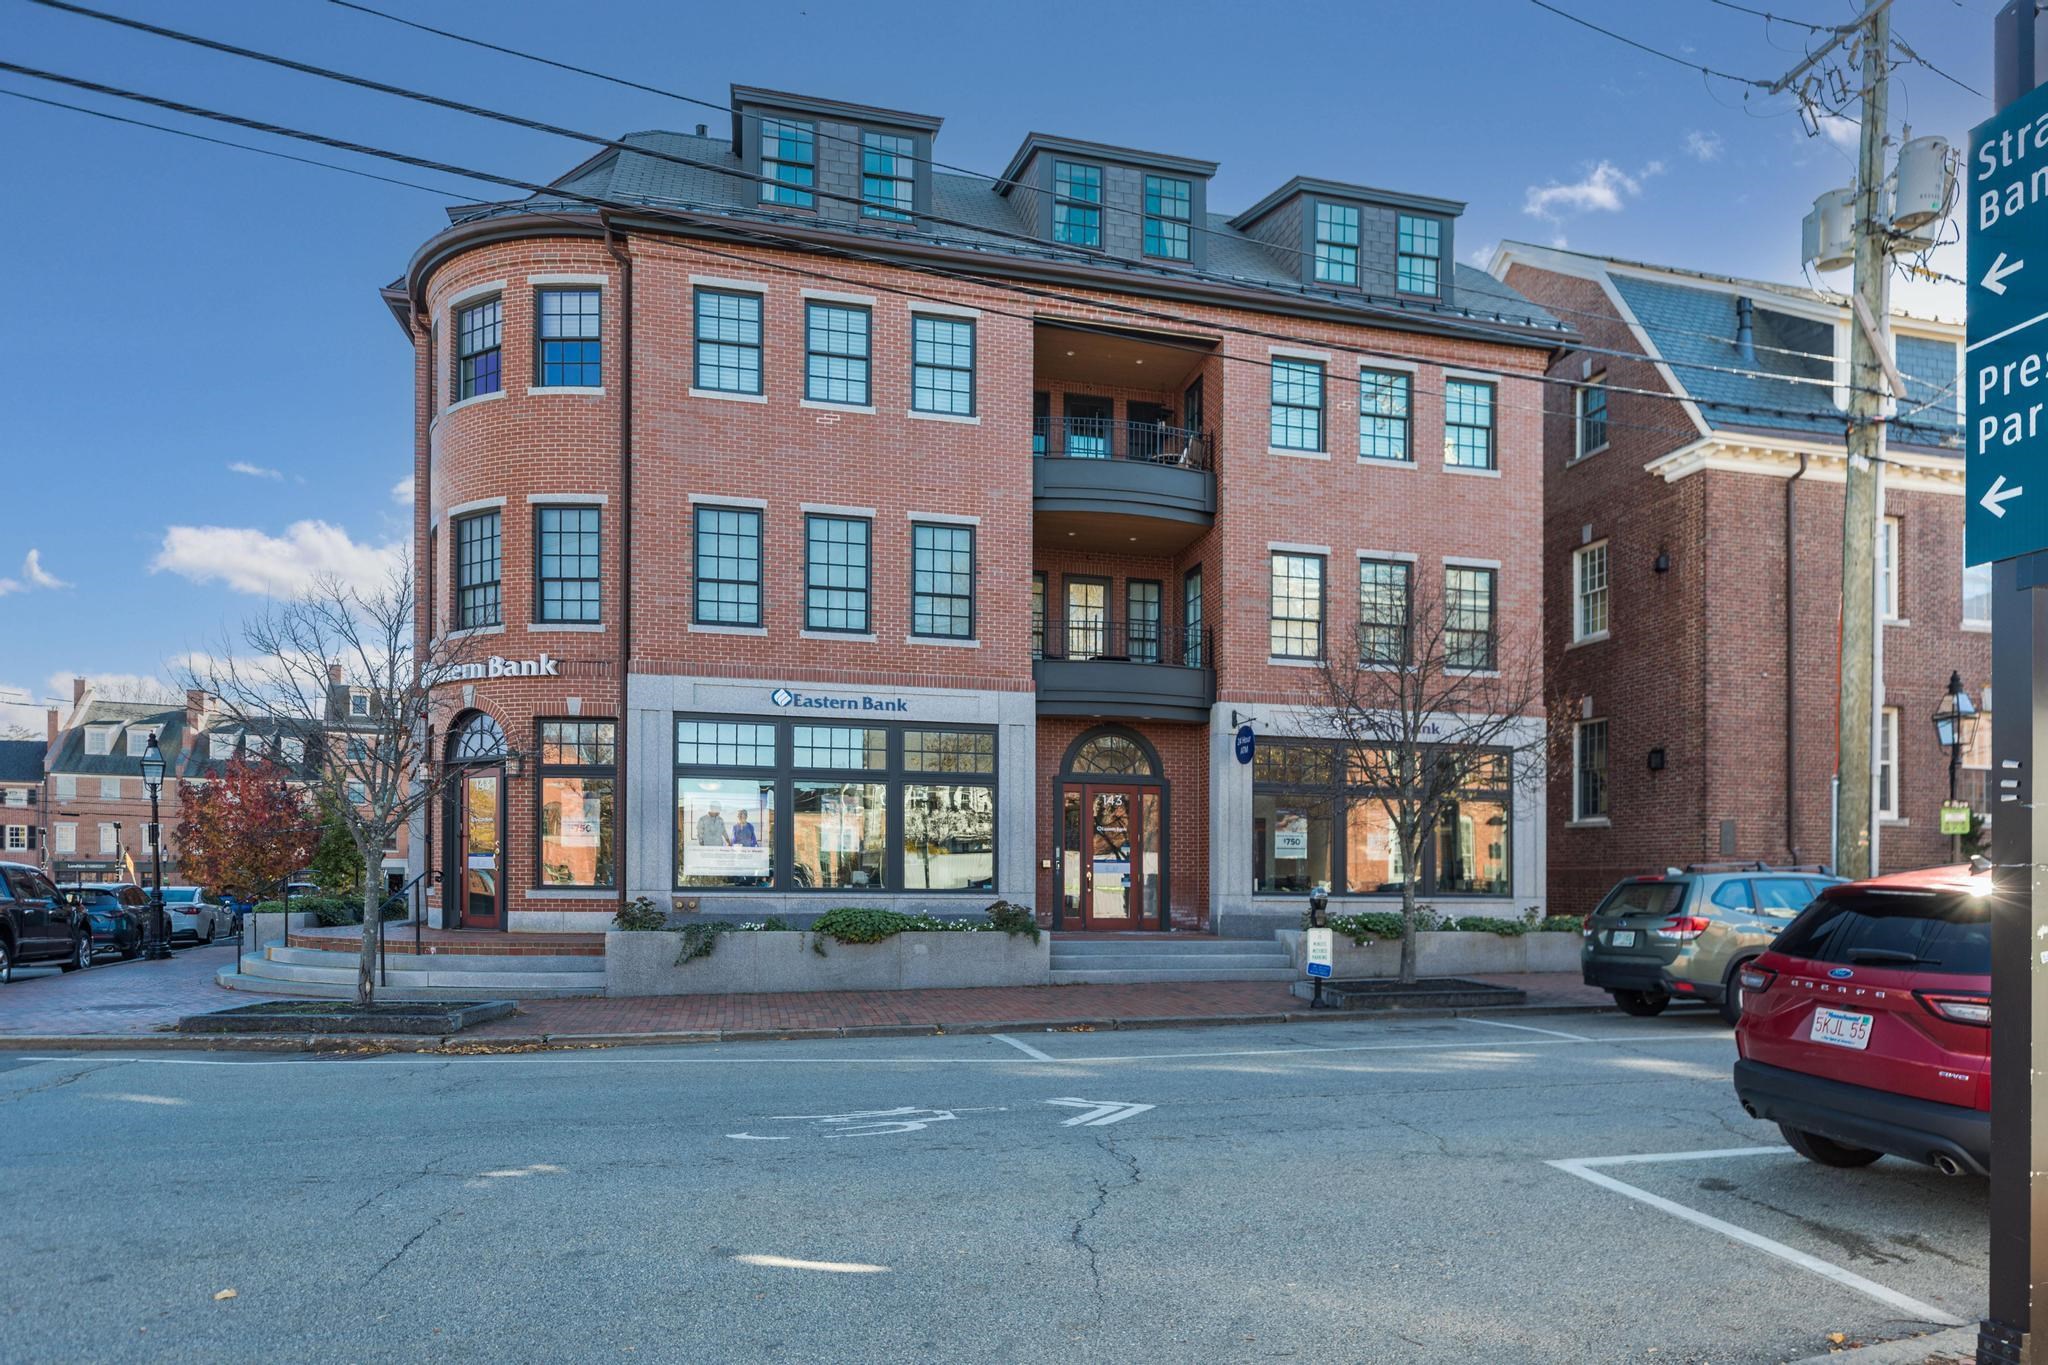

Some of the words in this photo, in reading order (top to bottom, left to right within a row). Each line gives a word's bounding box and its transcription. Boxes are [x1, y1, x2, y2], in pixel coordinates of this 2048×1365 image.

[1979, 353, 2048, 405] Pre
[488, 653, 559, 677] Bank
[793, 693, 858, 710] Eastern
[862, 696, 908, 712] Bank
[1103, 795, 1123, 806] 143
[1815, 1016, 1844, 1036] 5KJL
[1850, 1022, 1866, 1040] 55
